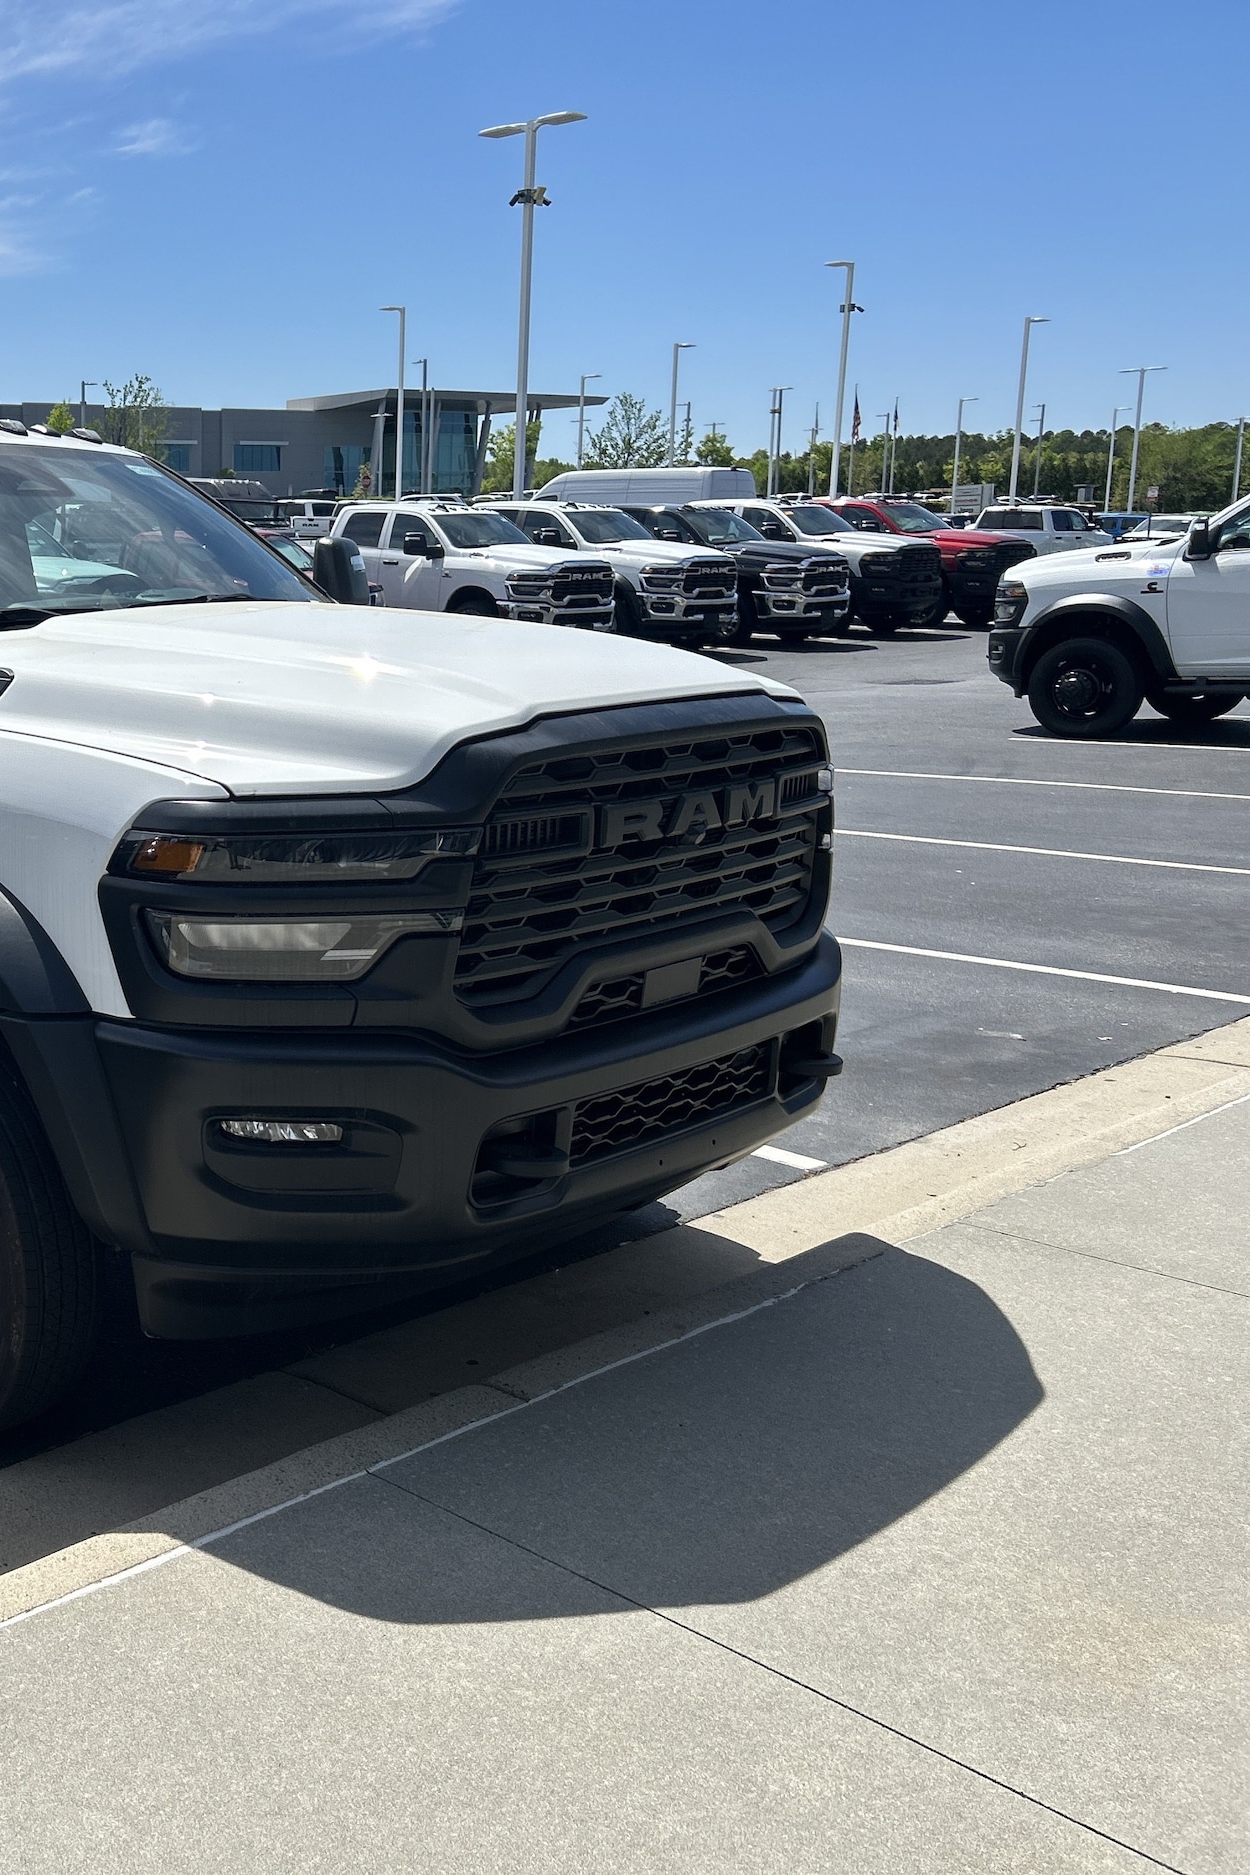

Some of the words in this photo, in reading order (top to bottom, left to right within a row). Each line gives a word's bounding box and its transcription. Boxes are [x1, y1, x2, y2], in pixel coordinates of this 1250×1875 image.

[701, 566, 727, 574] RAM
[571, 571, 601, 580] RAM
[600, 779, 775, 848] RAM
